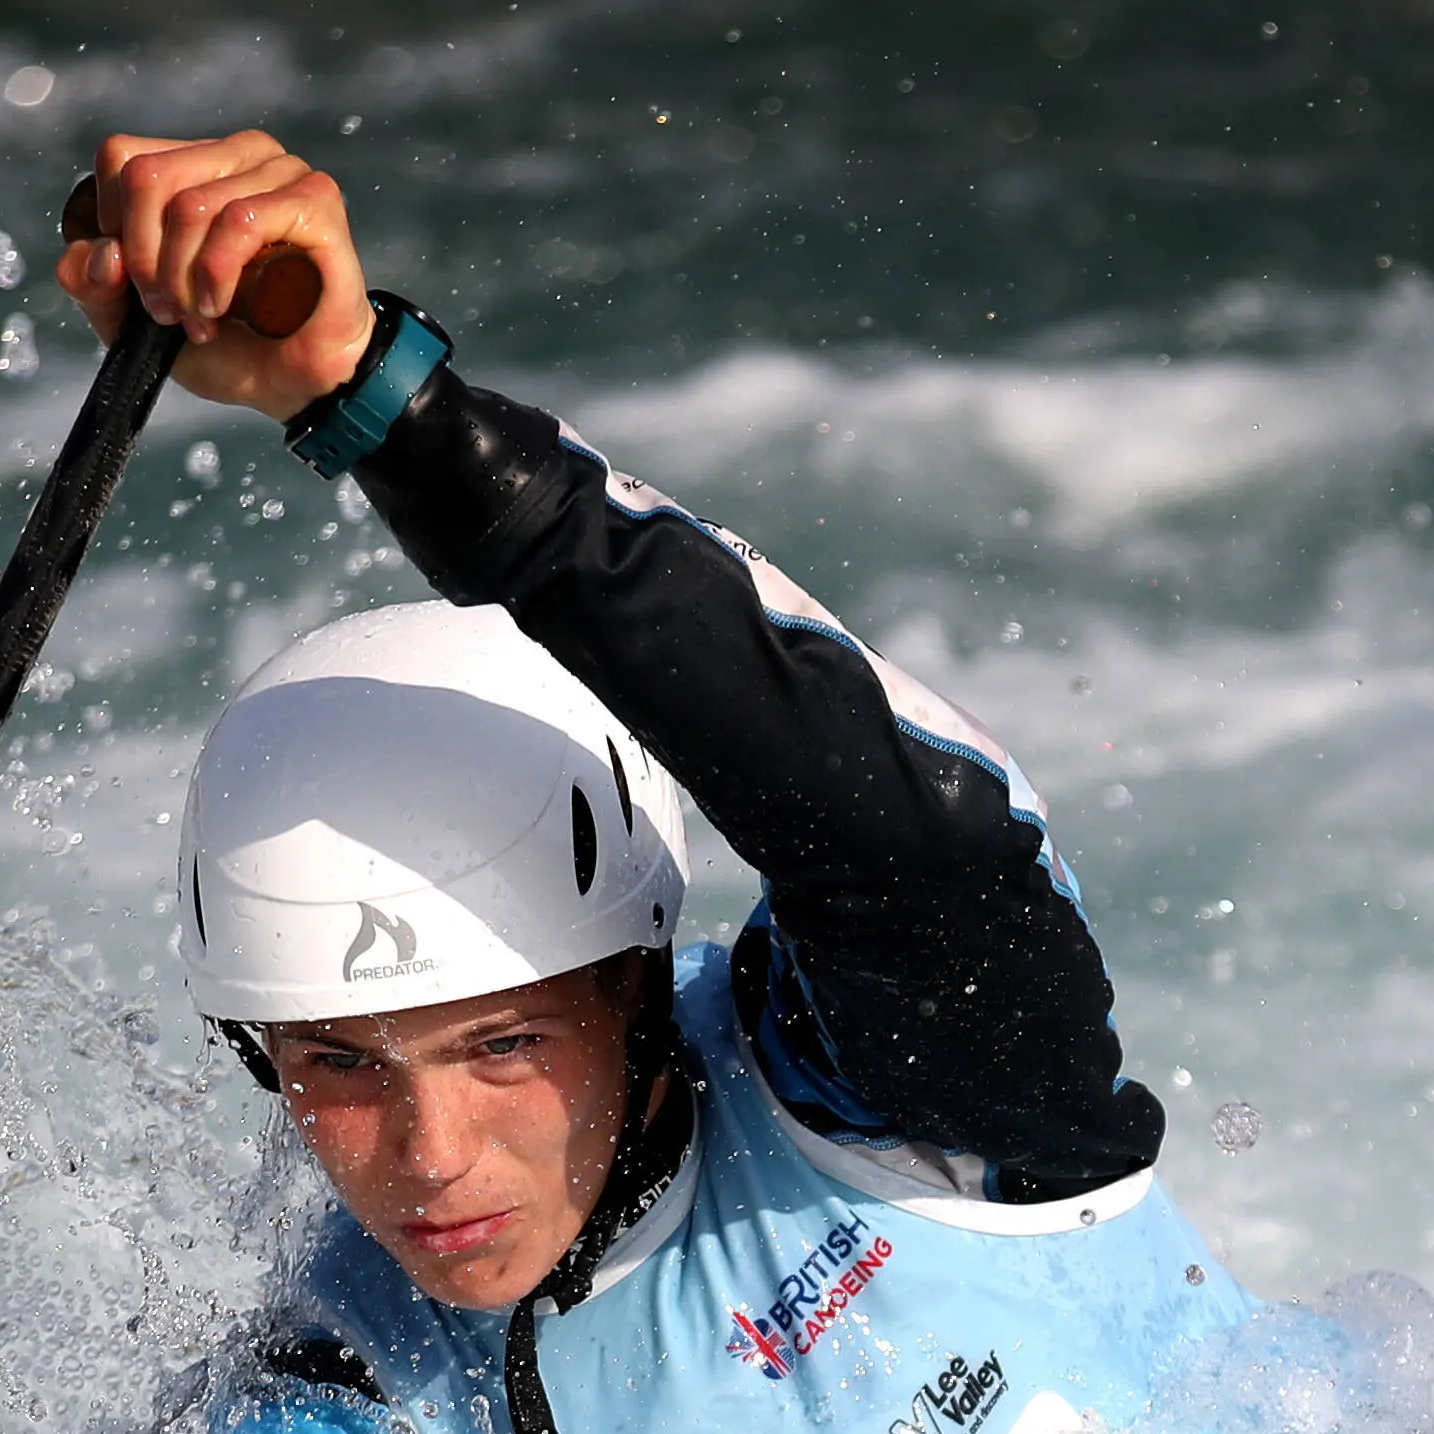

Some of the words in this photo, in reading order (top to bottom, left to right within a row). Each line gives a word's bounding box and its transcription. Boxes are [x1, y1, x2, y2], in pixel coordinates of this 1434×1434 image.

[353, 959, 436, 982] PREDATOR
[768, 1208, 870, 1332] BRITISH
[793, 1236, 893, 1355] CANOEING
[923, 1356, 969, 1409] Lee
[941, 1349, 1004, 1426] Valley
